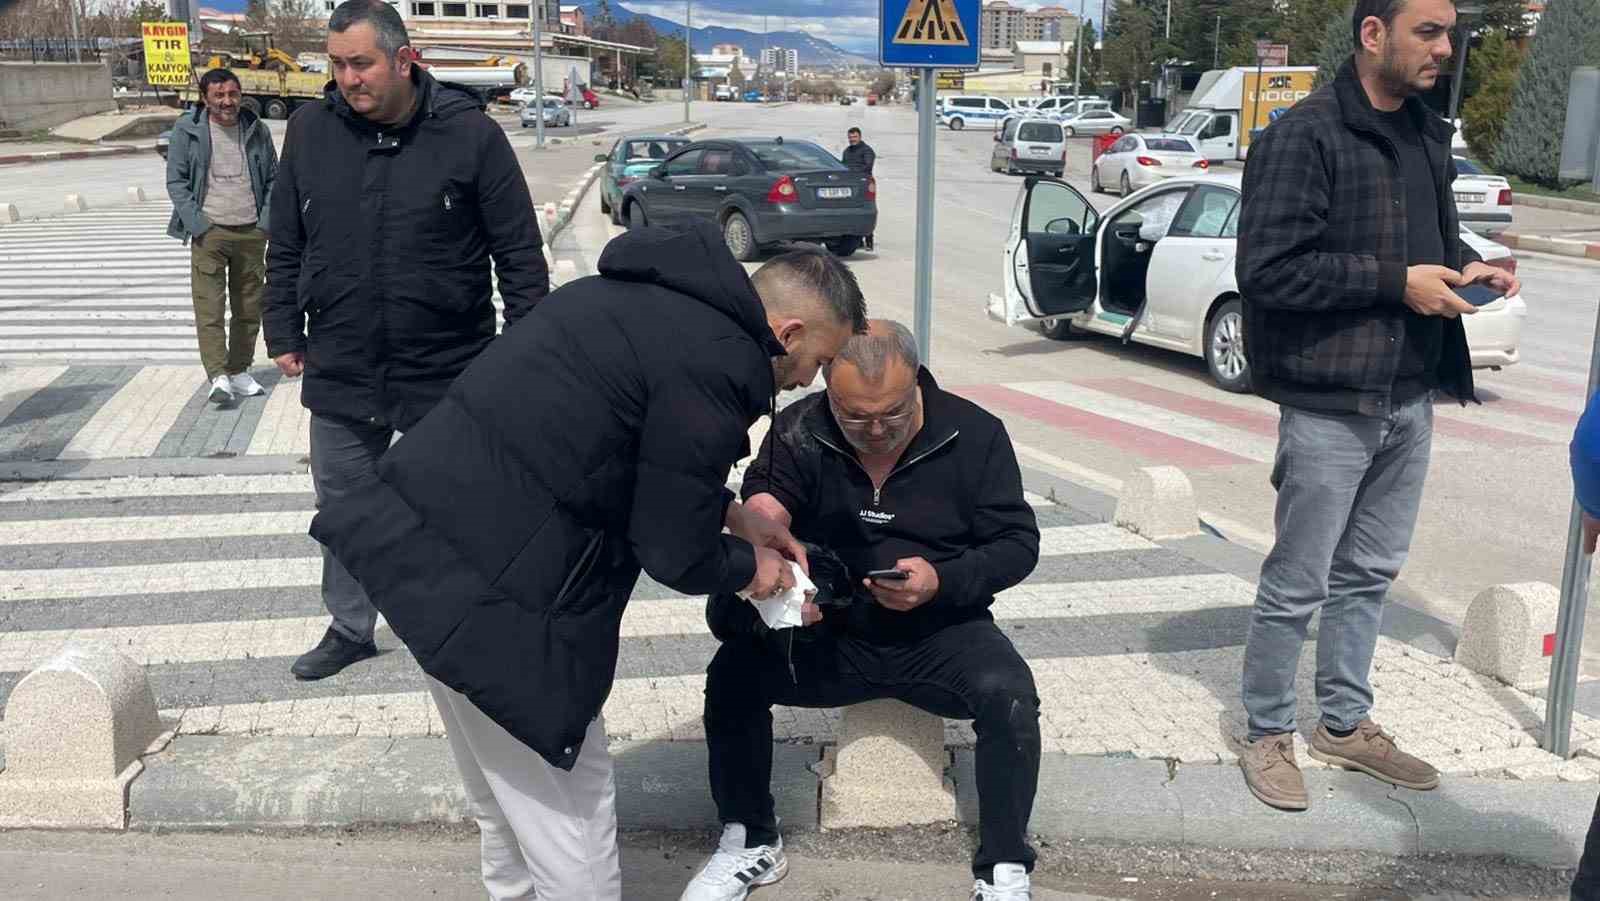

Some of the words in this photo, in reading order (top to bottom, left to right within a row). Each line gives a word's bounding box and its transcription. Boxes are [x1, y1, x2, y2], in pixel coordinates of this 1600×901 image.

[152, 39, 182, 49] TIR
[164, 51, 175, 62] &
[149, 63, 192, 73] KAMYON
[149, 74, 192, 83] YIKAMA
[859, 509, 867, 517] JJ
